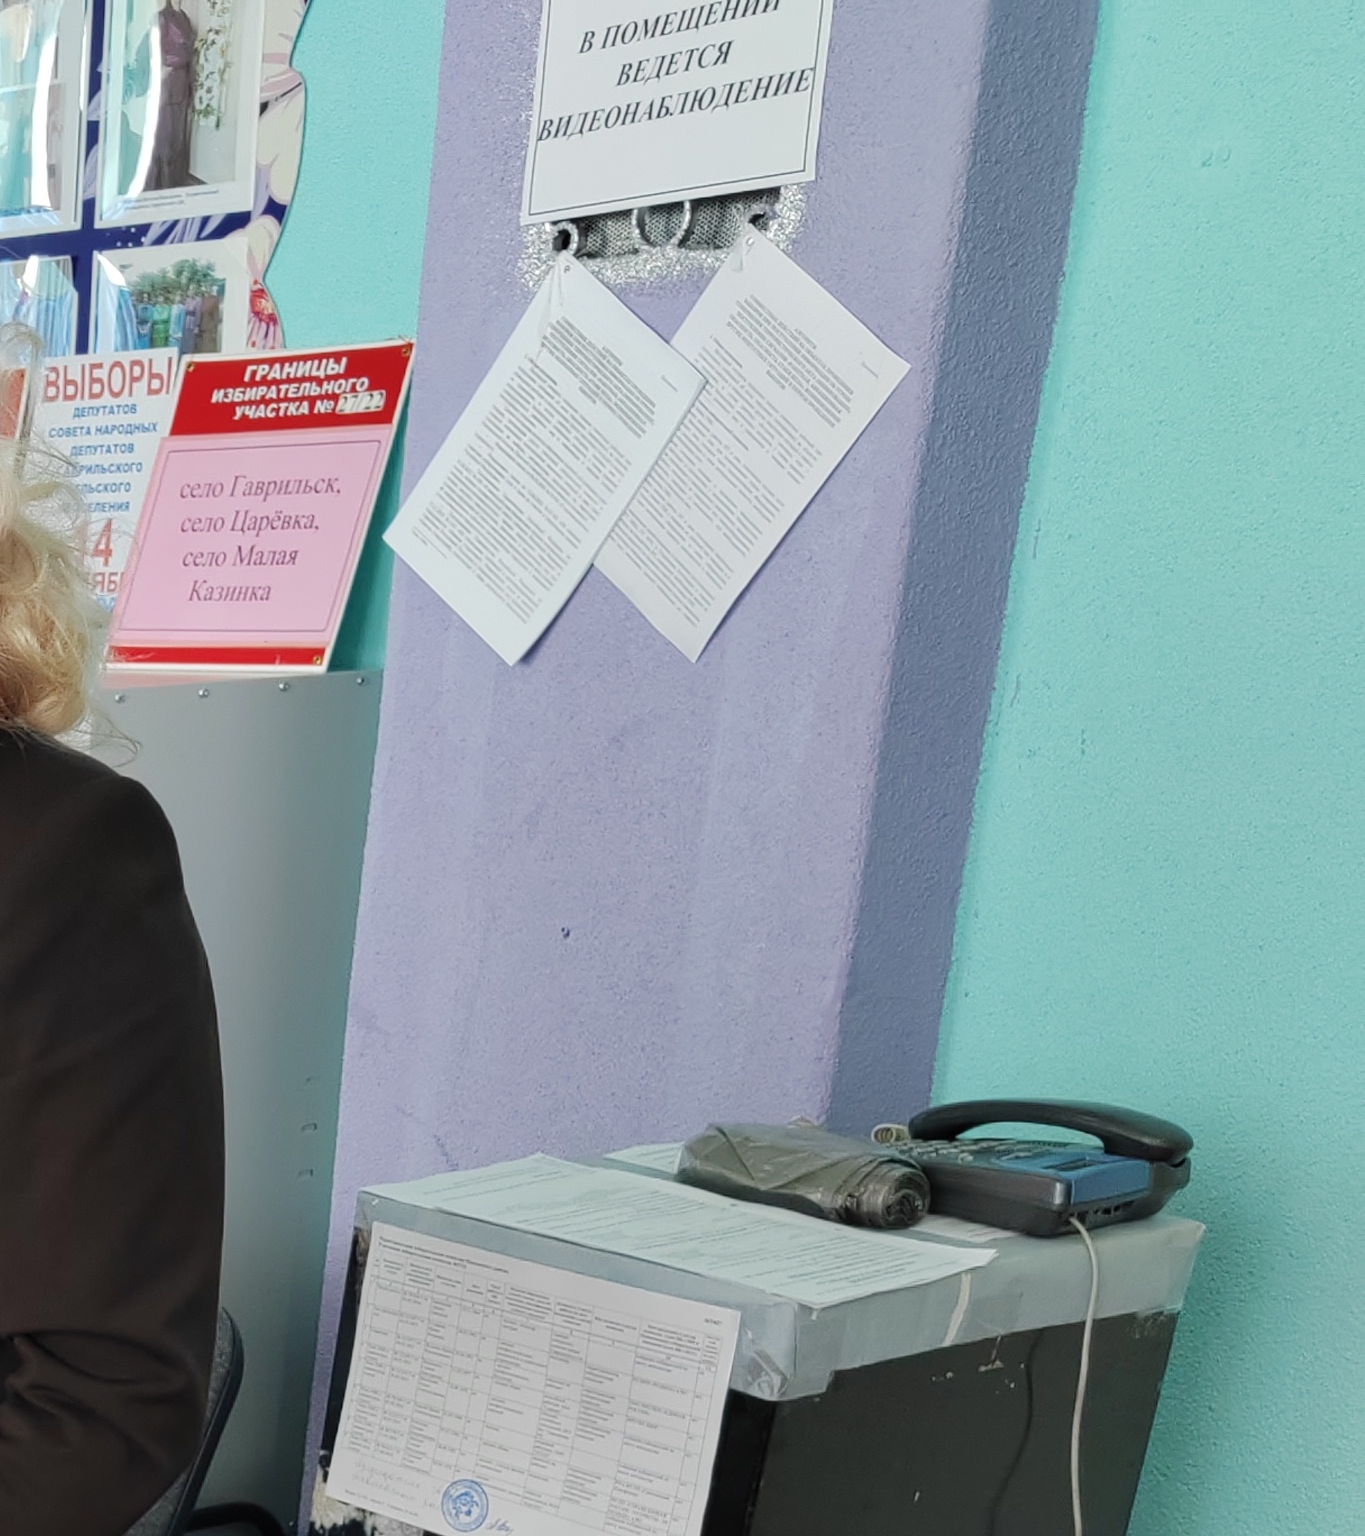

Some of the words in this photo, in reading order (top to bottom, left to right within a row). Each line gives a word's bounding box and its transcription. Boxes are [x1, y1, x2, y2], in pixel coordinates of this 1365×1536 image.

[578, 31, 595, 54] В
[600, 0, 781, 49] ПОМЕЩЕНИИ
[615, 40, 735, 87] ВЕДЕТСЯ
[537, 67, 815, 142] ВИДЕОНАБЛЮДЕНИЕ
[43, 357, 173, 403] ВЫБОРЫ
[243, 356, 348, 382] ГРАНИЦЫ
[211, 377, 369, 404] ИЗБИРАТЕЛЬНОГО
[72, 403, 138, 420] ДЕПУТАТОВ
[233, 401, 310, 420] УЧАСТКА
[313, 399, 335, 414] №
[48, 426, 92, 439] СОВЕТА
[95, 421, 159, 437] НАРОДНЫХ
[70, 443, 135, 458] ДЕПУТАТОВ
[179, 480, 224, 500] село
[228, 474, 342, 503] Гаврильск,
[179, 515, 226, 533] село
[229, 509, 320, 538] Царёвка,
[181, 549, 227, 568] село
[231, 545, 299, 568] Малая
[187, 580, 272, 603] Казинка
